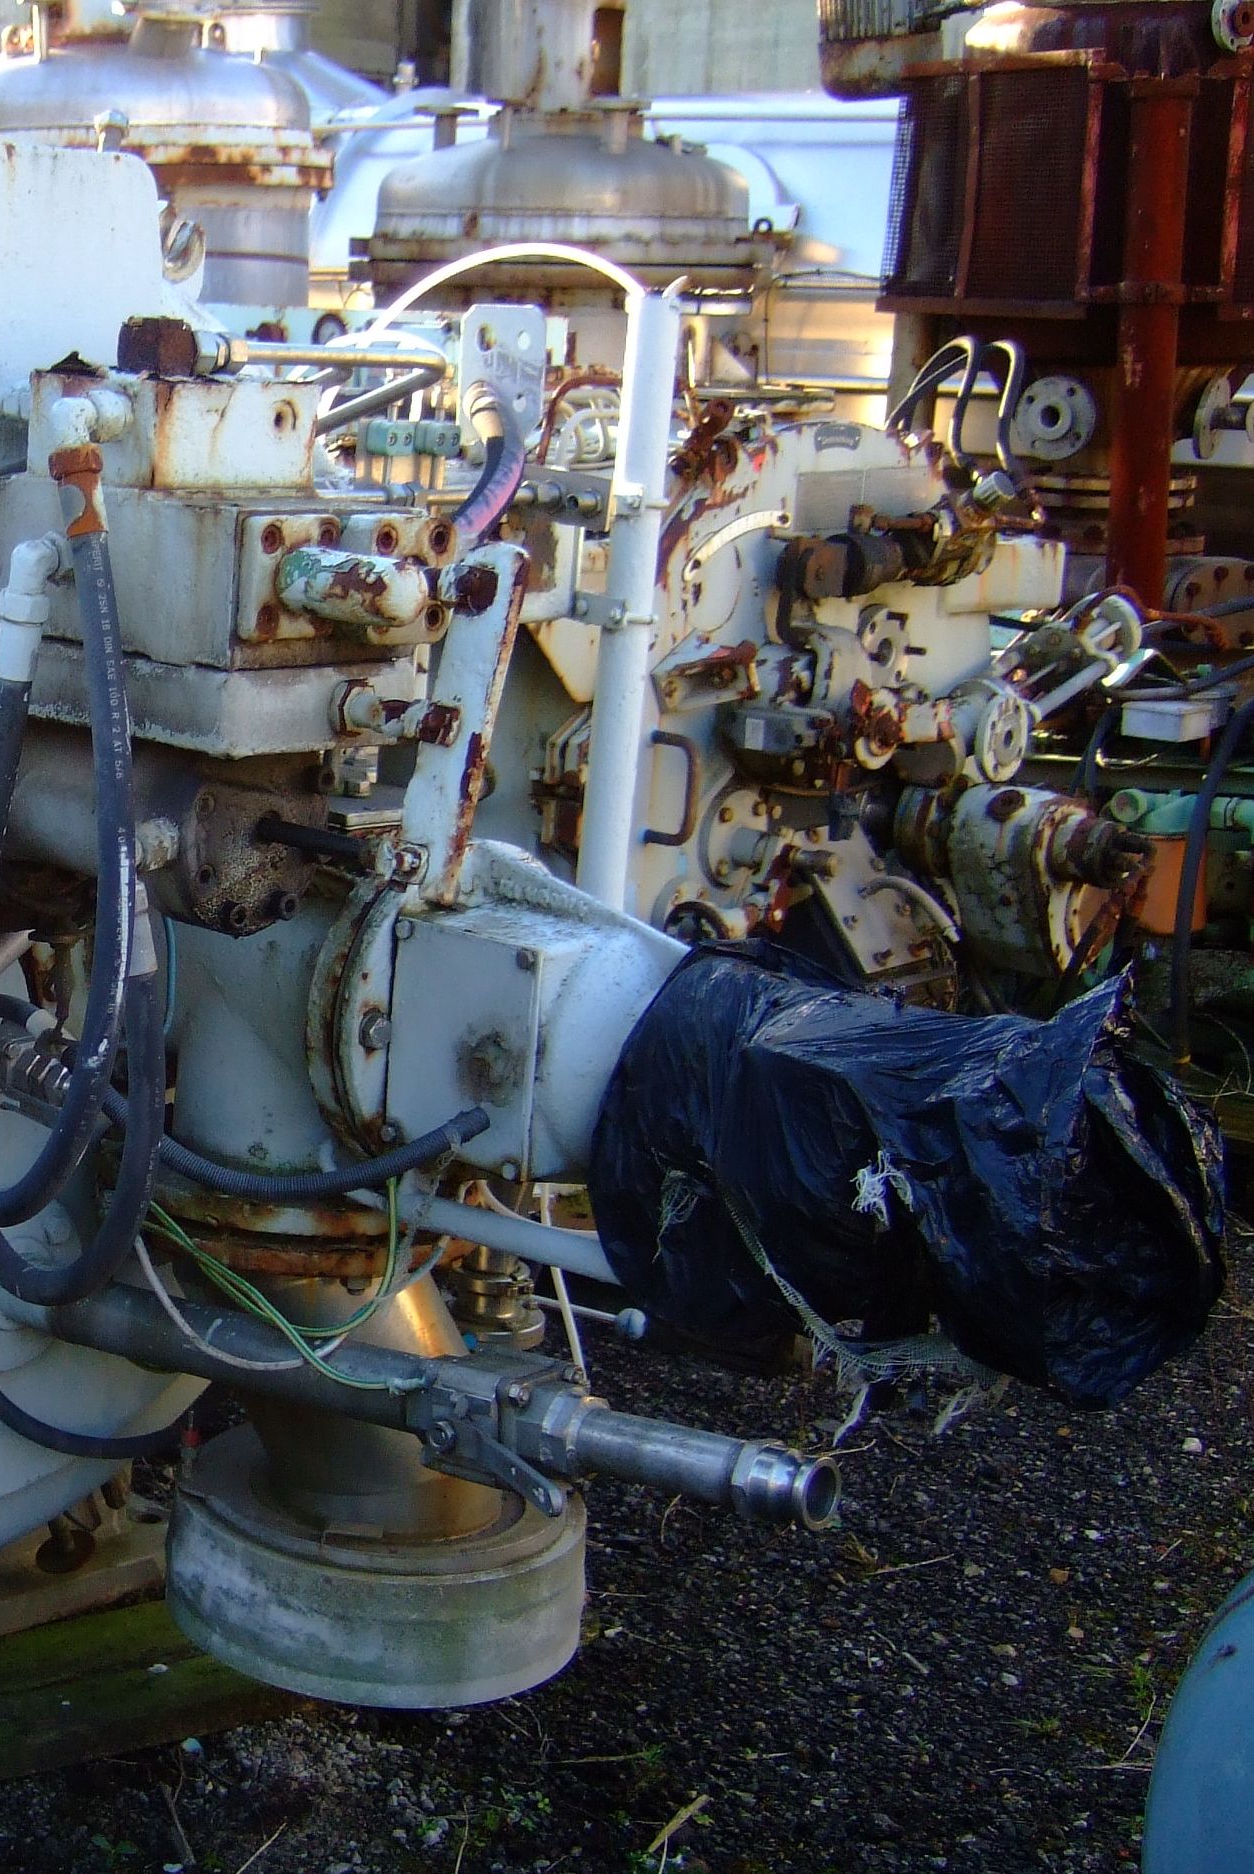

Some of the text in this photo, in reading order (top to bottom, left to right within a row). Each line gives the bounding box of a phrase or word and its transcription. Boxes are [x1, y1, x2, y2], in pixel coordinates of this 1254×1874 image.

[91, 541, 103, 571] PERIT
[98, 593, 109, 614] 2SN
[103, 636, 114, 654] DIN
[106, 660, 117, 681] SAE
[108, 687, 121, 706] 100
[111, 712, 120, 720] R
[113, 739, 123, 754] AT
